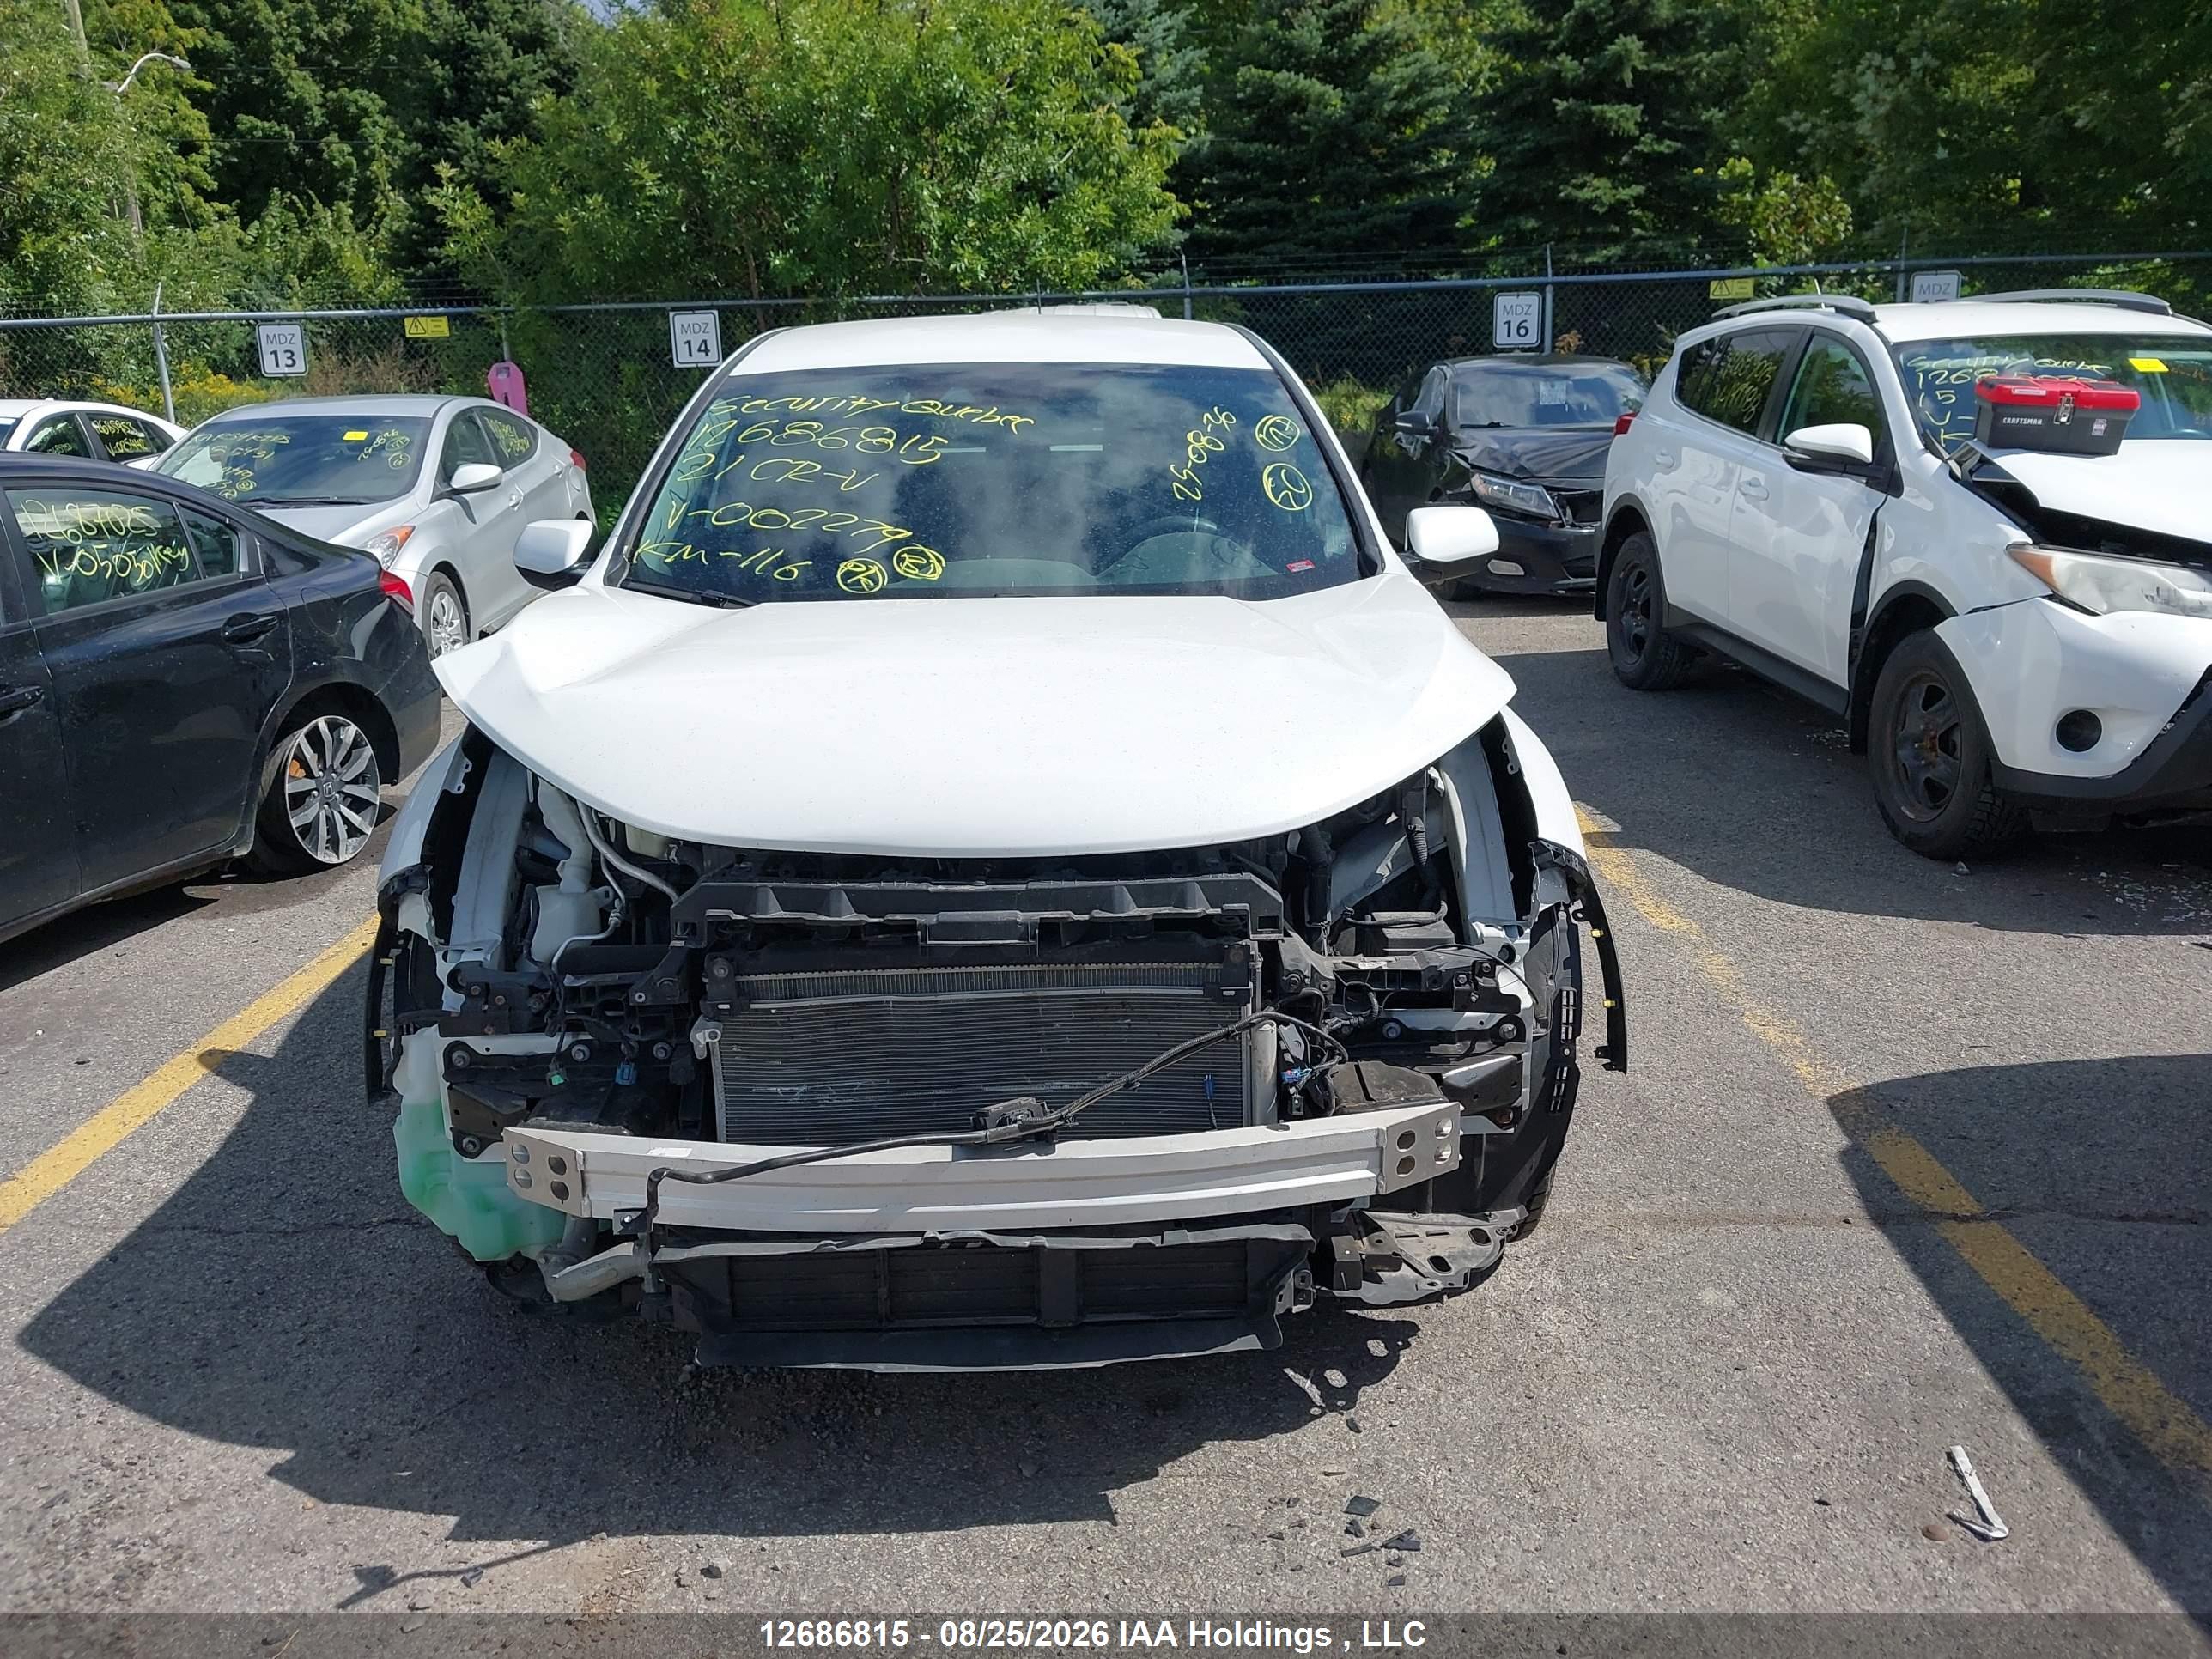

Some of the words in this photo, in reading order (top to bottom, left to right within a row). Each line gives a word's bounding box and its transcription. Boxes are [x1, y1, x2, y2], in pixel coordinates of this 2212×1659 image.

[1918, 282, 1951, 295] MDZ
[1503, 304, 1533, 316] MDZ
[680, 322, 710, 335] MDZ
[1504, 319, 1529, 337] 16
[266, 333, 295, 345] MDZ
[684, 339, 710, 357] 14
[270, 349, 296, 368] 13
[2002, 417, 2043, 426] CRAFTSMAN
[686, 420, 948, 464] 12686815
[677, 453, 744, 482] 21
